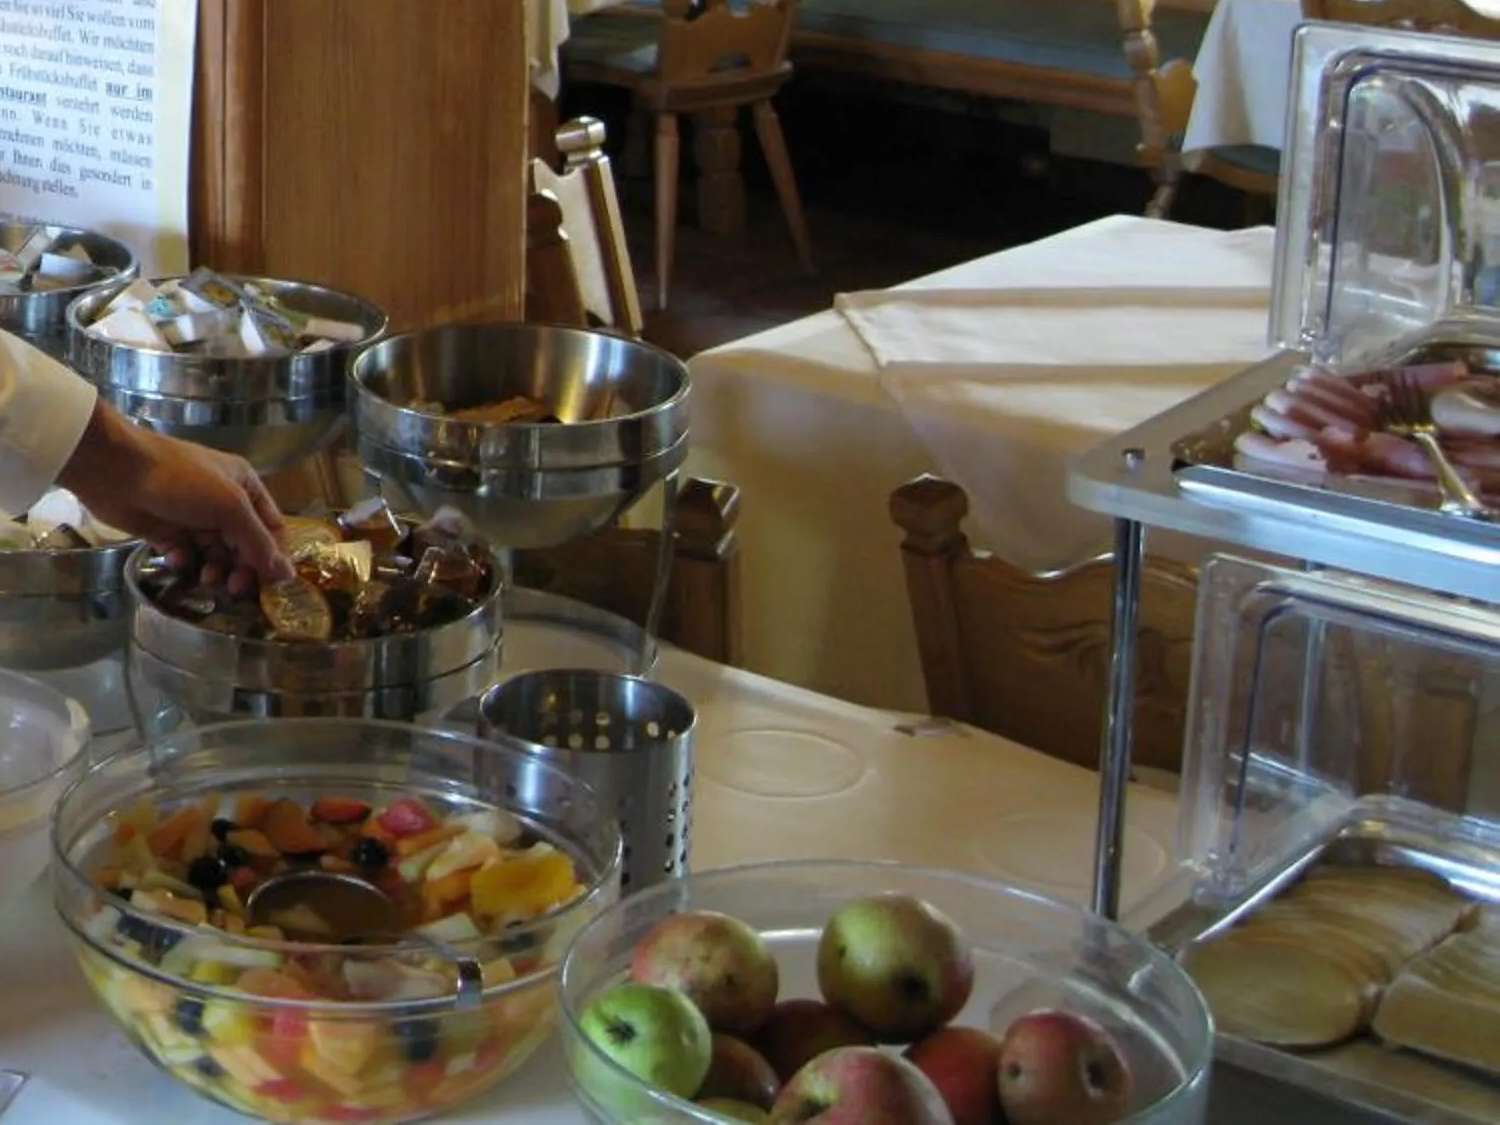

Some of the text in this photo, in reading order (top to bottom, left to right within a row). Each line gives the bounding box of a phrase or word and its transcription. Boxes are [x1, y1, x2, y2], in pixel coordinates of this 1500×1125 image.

[105, 82, 128, 98] nur
[136, 82, 153, 101] im
[79, 118, 101, 138] Sie
[111, 124, 154, 147] etwas
